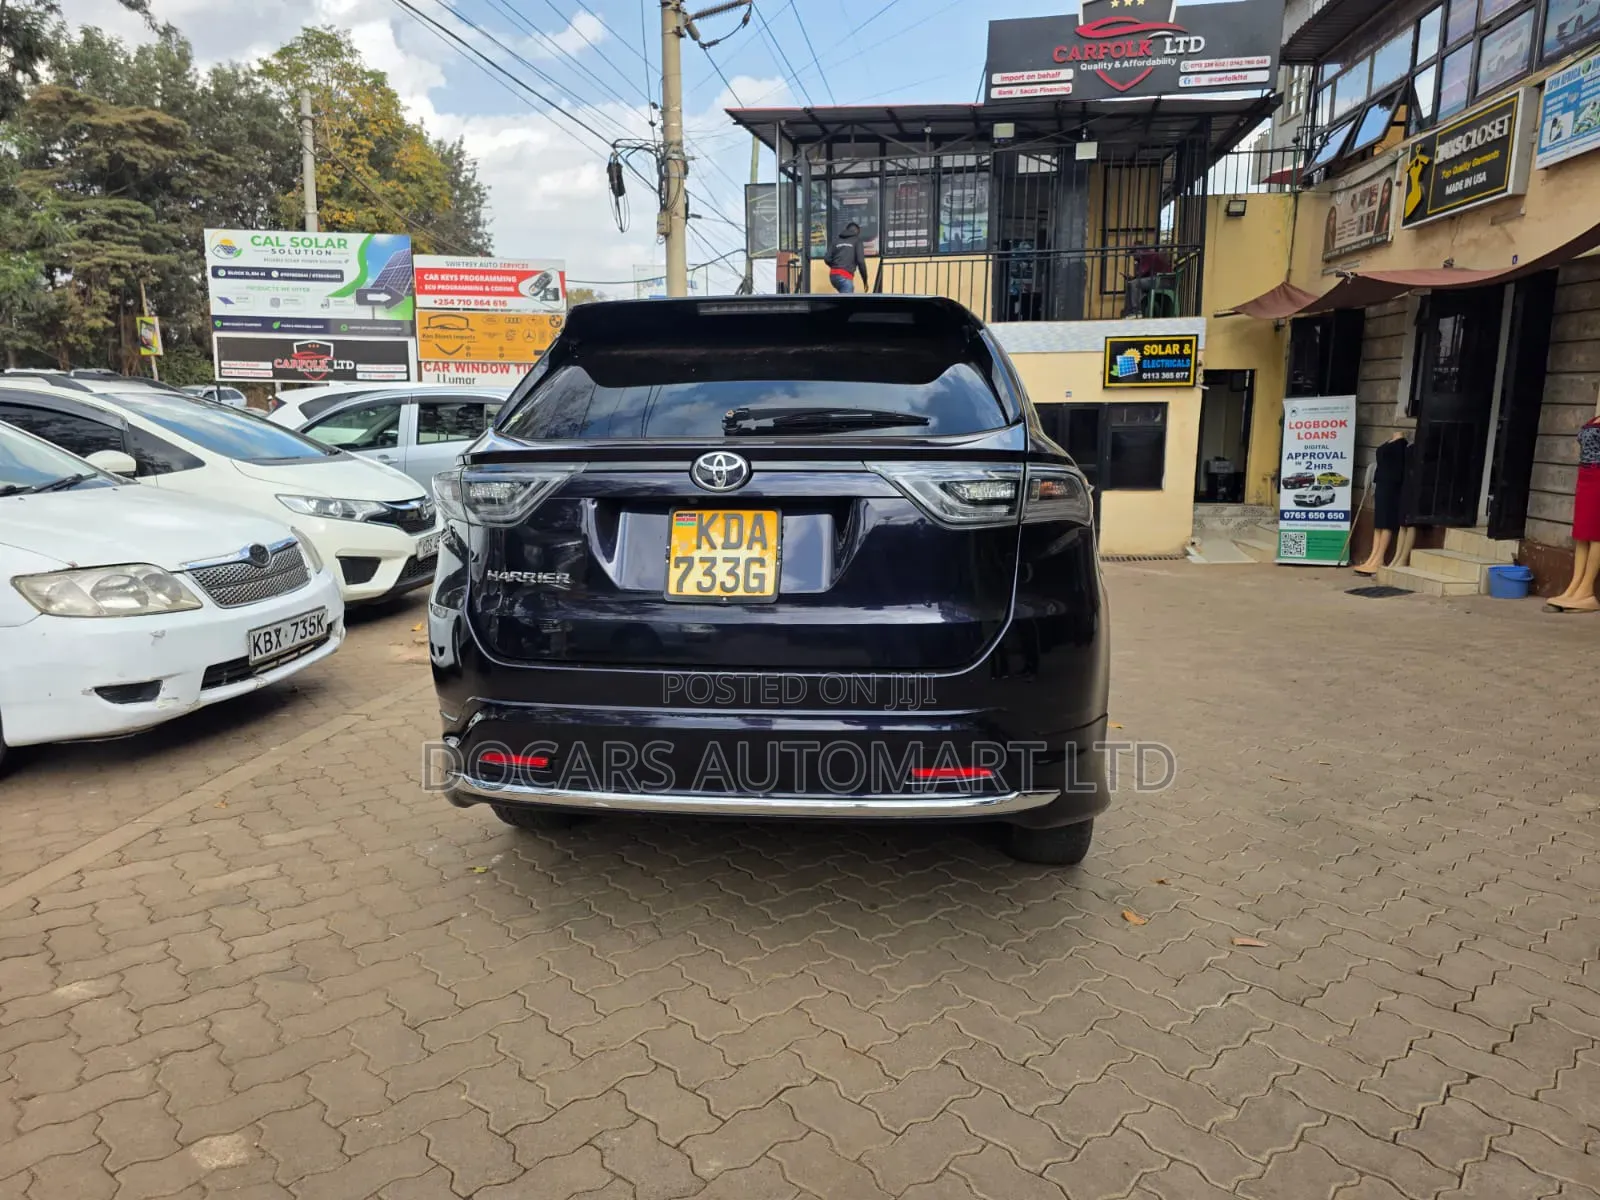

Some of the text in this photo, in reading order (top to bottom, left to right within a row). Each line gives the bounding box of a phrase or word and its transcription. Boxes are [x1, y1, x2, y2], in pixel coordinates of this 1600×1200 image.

[1053, 36, 1205, 62] CARFOLK LTD
[1080, 61, 1113, 71] Quality
[1122, 57, 1177, 69] Affordability
[1037, 72, 1061, 80] behalf
[1039, 86, 1070, 94] Financing
[1445, 171, 1487, 196] MADE IN USA
[251, 235, 348, 249] CAL SOLAR
[271, 248, 332, 256] SOLUTION
[424, 273, 517, 283] CAR KEYS PROGRAMMING
[1143, 344, 1191, 355] SOLAR &
[274, 358, 329, 369] CARFOLK
[333, 360, 355, 370] LTD
[423, 361, 450, 373] CAR
[454, 362, 510, 374] WINDOW
[1142, 358, 1190, 369] ELECTRICALS
[1288, 420, 1348, 430] LOGBOOK
[1297, 431, 1337, 440] LOANS
[1286, 452, 1347, 460] APPROVAL
[1305, 461, 1313, 470] 2
[1283, 511, 1345, 520] 0765 650 650
[696, 512, 767, 550] KDA
[487, 569, 571, 584] HARRIER
[674, 556, 766, 593] 733G
[252, 613, 325, 657] KBX 735K
